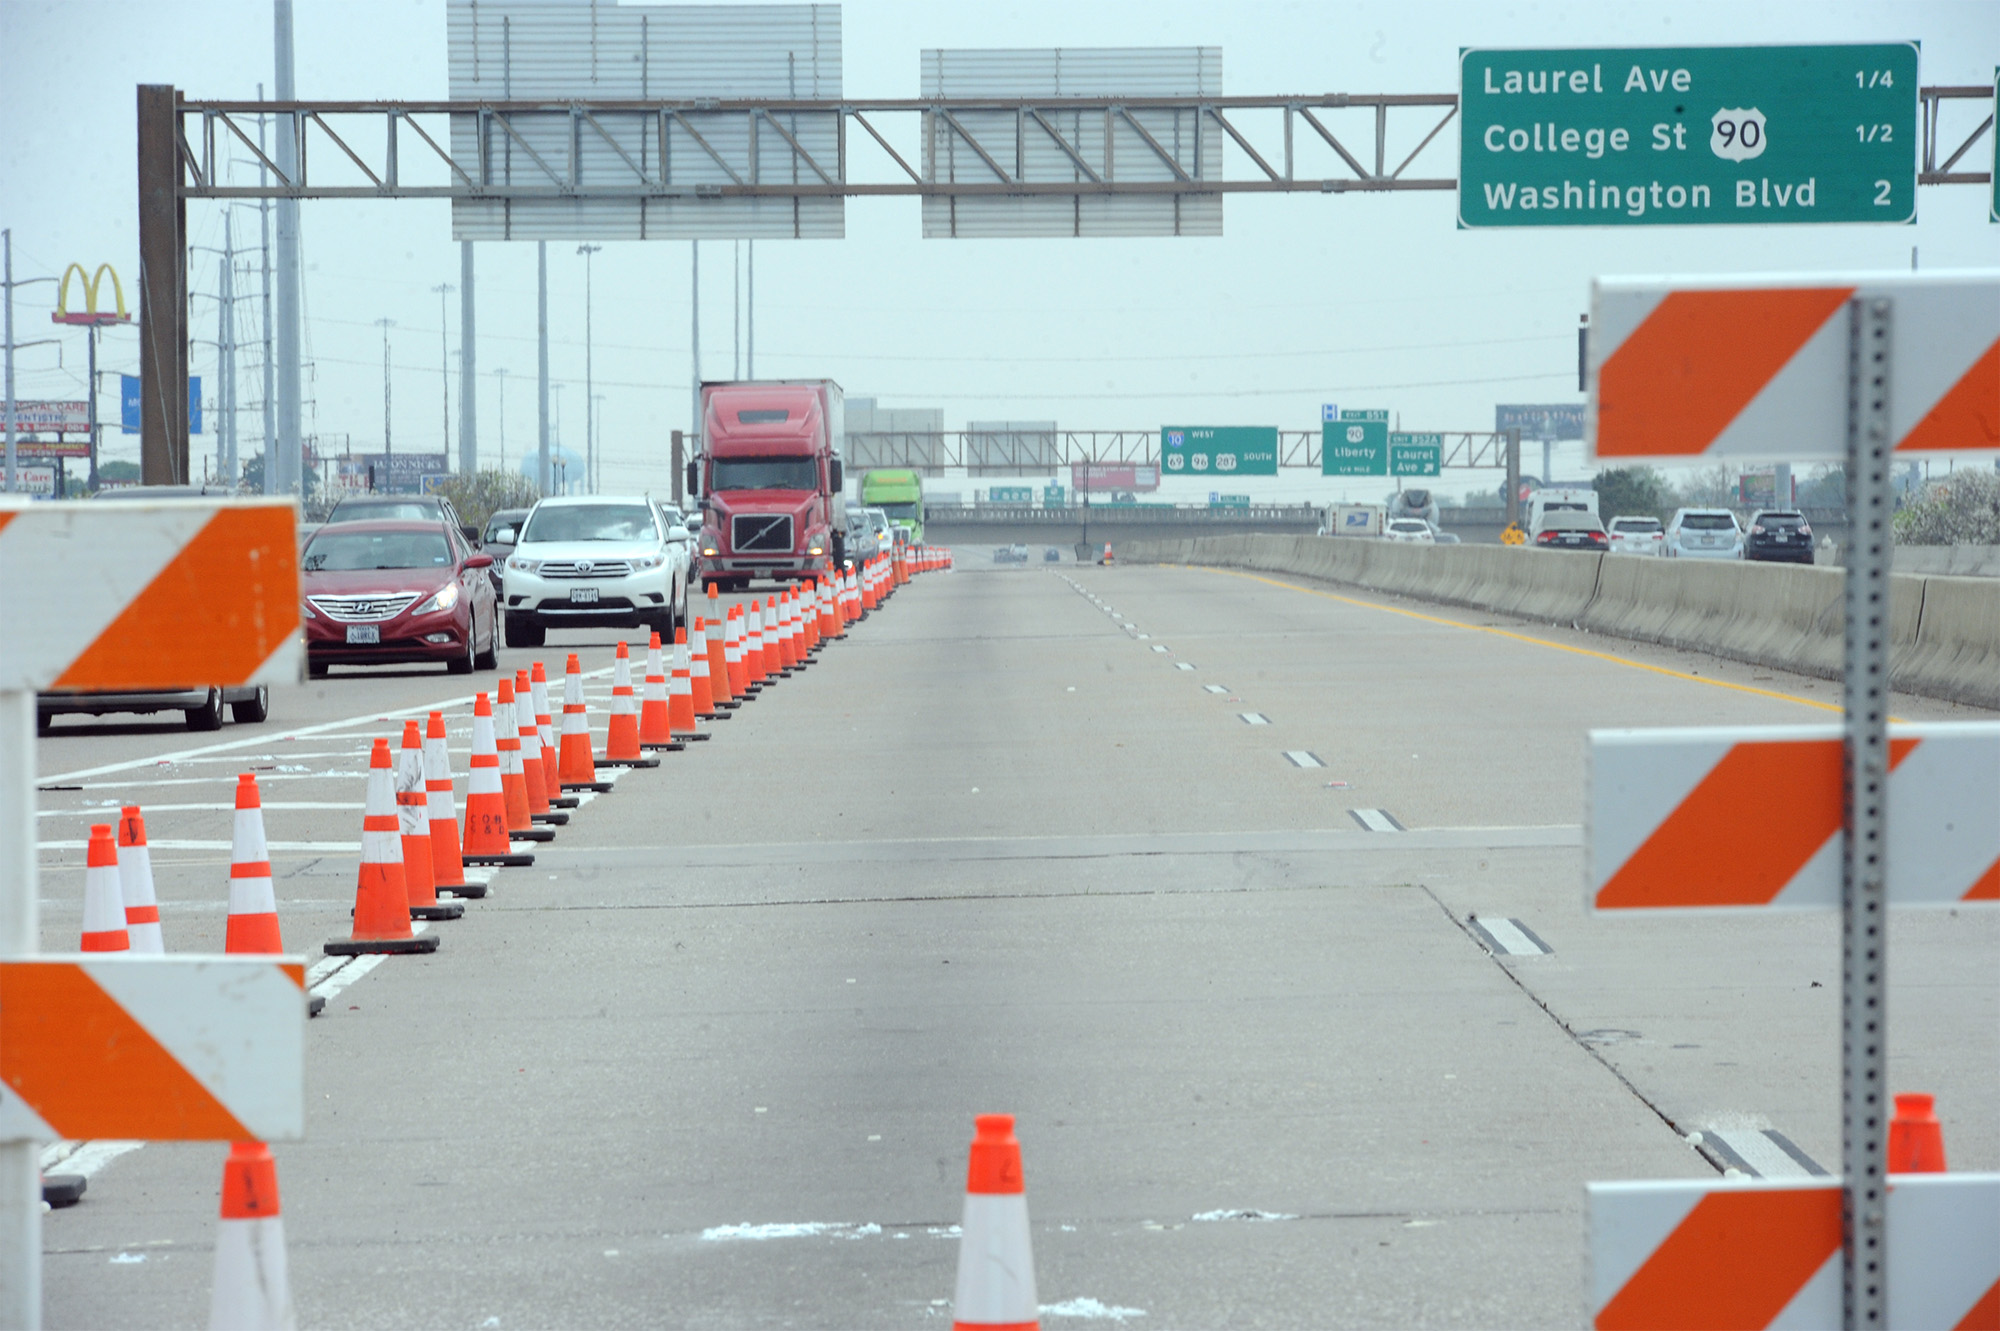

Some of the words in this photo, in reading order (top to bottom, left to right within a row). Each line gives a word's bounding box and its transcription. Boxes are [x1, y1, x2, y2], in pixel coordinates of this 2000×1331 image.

[1484, 64, 1603, 94] Laurel
[1624, 65, 1692, 93] Ave
[1855, 70, 1894, 88] 1/4
[1484, 122, 1630, 159] College
[1652, 122, 1687, 150] St
[1717, 120, 1760, 148] 90
[1855, 124, 1893, 142] 1/2
[1483, 179, 1711, 216] Washington
[1736, 177, 1815, 207] Blvd
[1873, 179, 1891, 206] 2
[1171, 436, 1182, 446] 10
[1191, 430, 1214, 438] WEST
[1348, 429, 1363, 439] 90
[1169, 456, 1182, 466] 69
[1193, 456, 1207, 466] 96
[1217, 456, 1235, 466] 287
[1243, 452, 1272, 460] SOUTH
[1335, 447, 1376, 459] Liberty
[1397, 449, 1434, 460] Laurel
[1397, 461, 1418, 472] Ave
